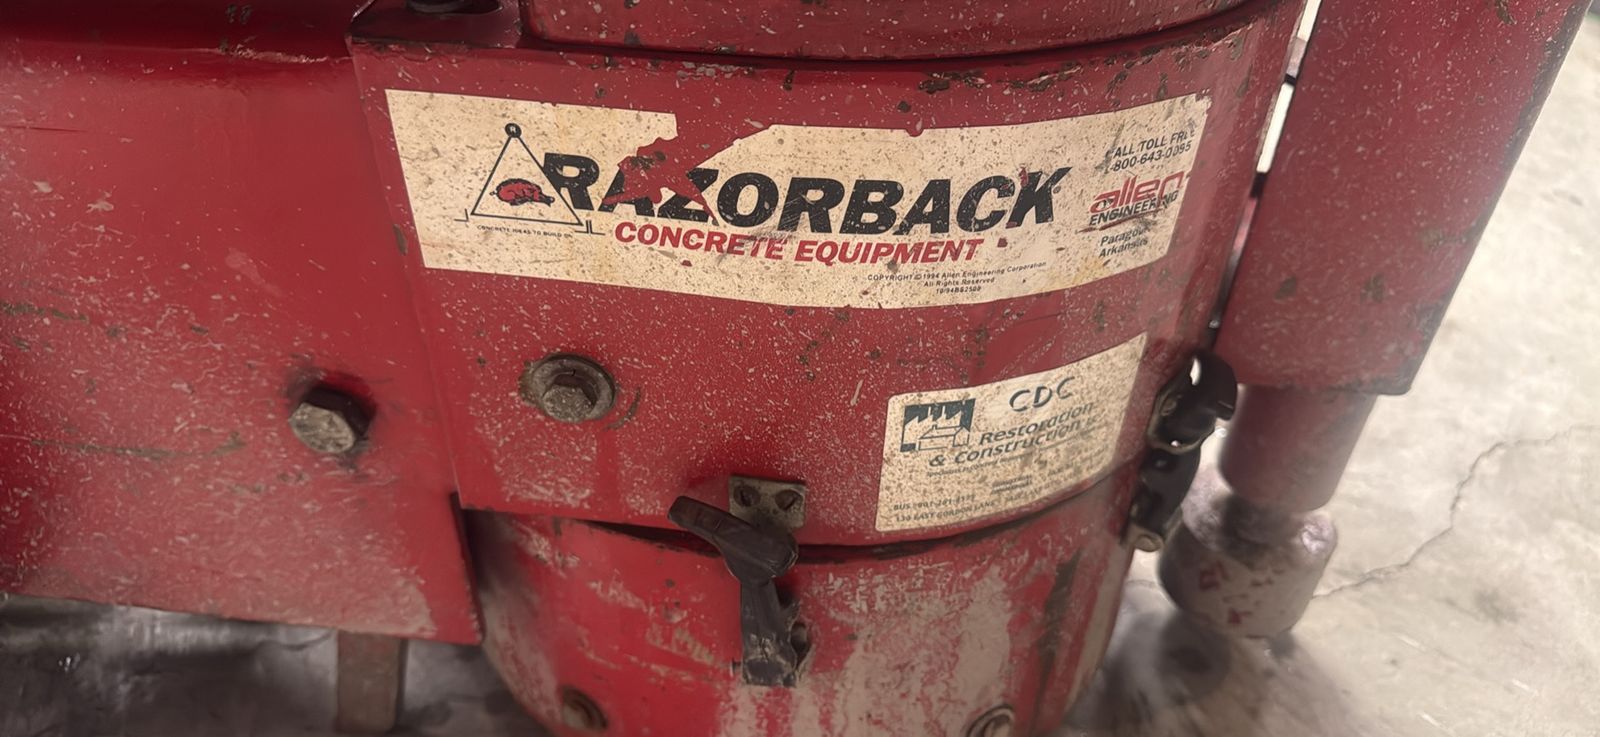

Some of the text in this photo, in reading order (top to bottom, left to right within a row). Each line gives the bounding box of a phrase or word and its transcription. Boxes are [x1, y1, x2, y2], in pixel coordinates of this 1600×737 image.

[1139, 135, 1169, 152] TOLL
[1088, 190, 1179, 227] ENGINEERING
[1089, 171, 1185, 214] allen
[614, 221, 984, 267] CONCRETE EQUIPMENT
[936, 279, 960, 287] Rights
[961, 276, 995, 285] Reserved
[941, 272, 961, 280] Allen
[961, 268, 1005, 279] Engineering
[1006, 261, 1047, 273] Corporation
[1008, 376, 1076, 412] CDC
[978, 401, 1094, 446] Restoration
[928, 454, 946, 467] &
[954, 419, 1081, 464] Construction
